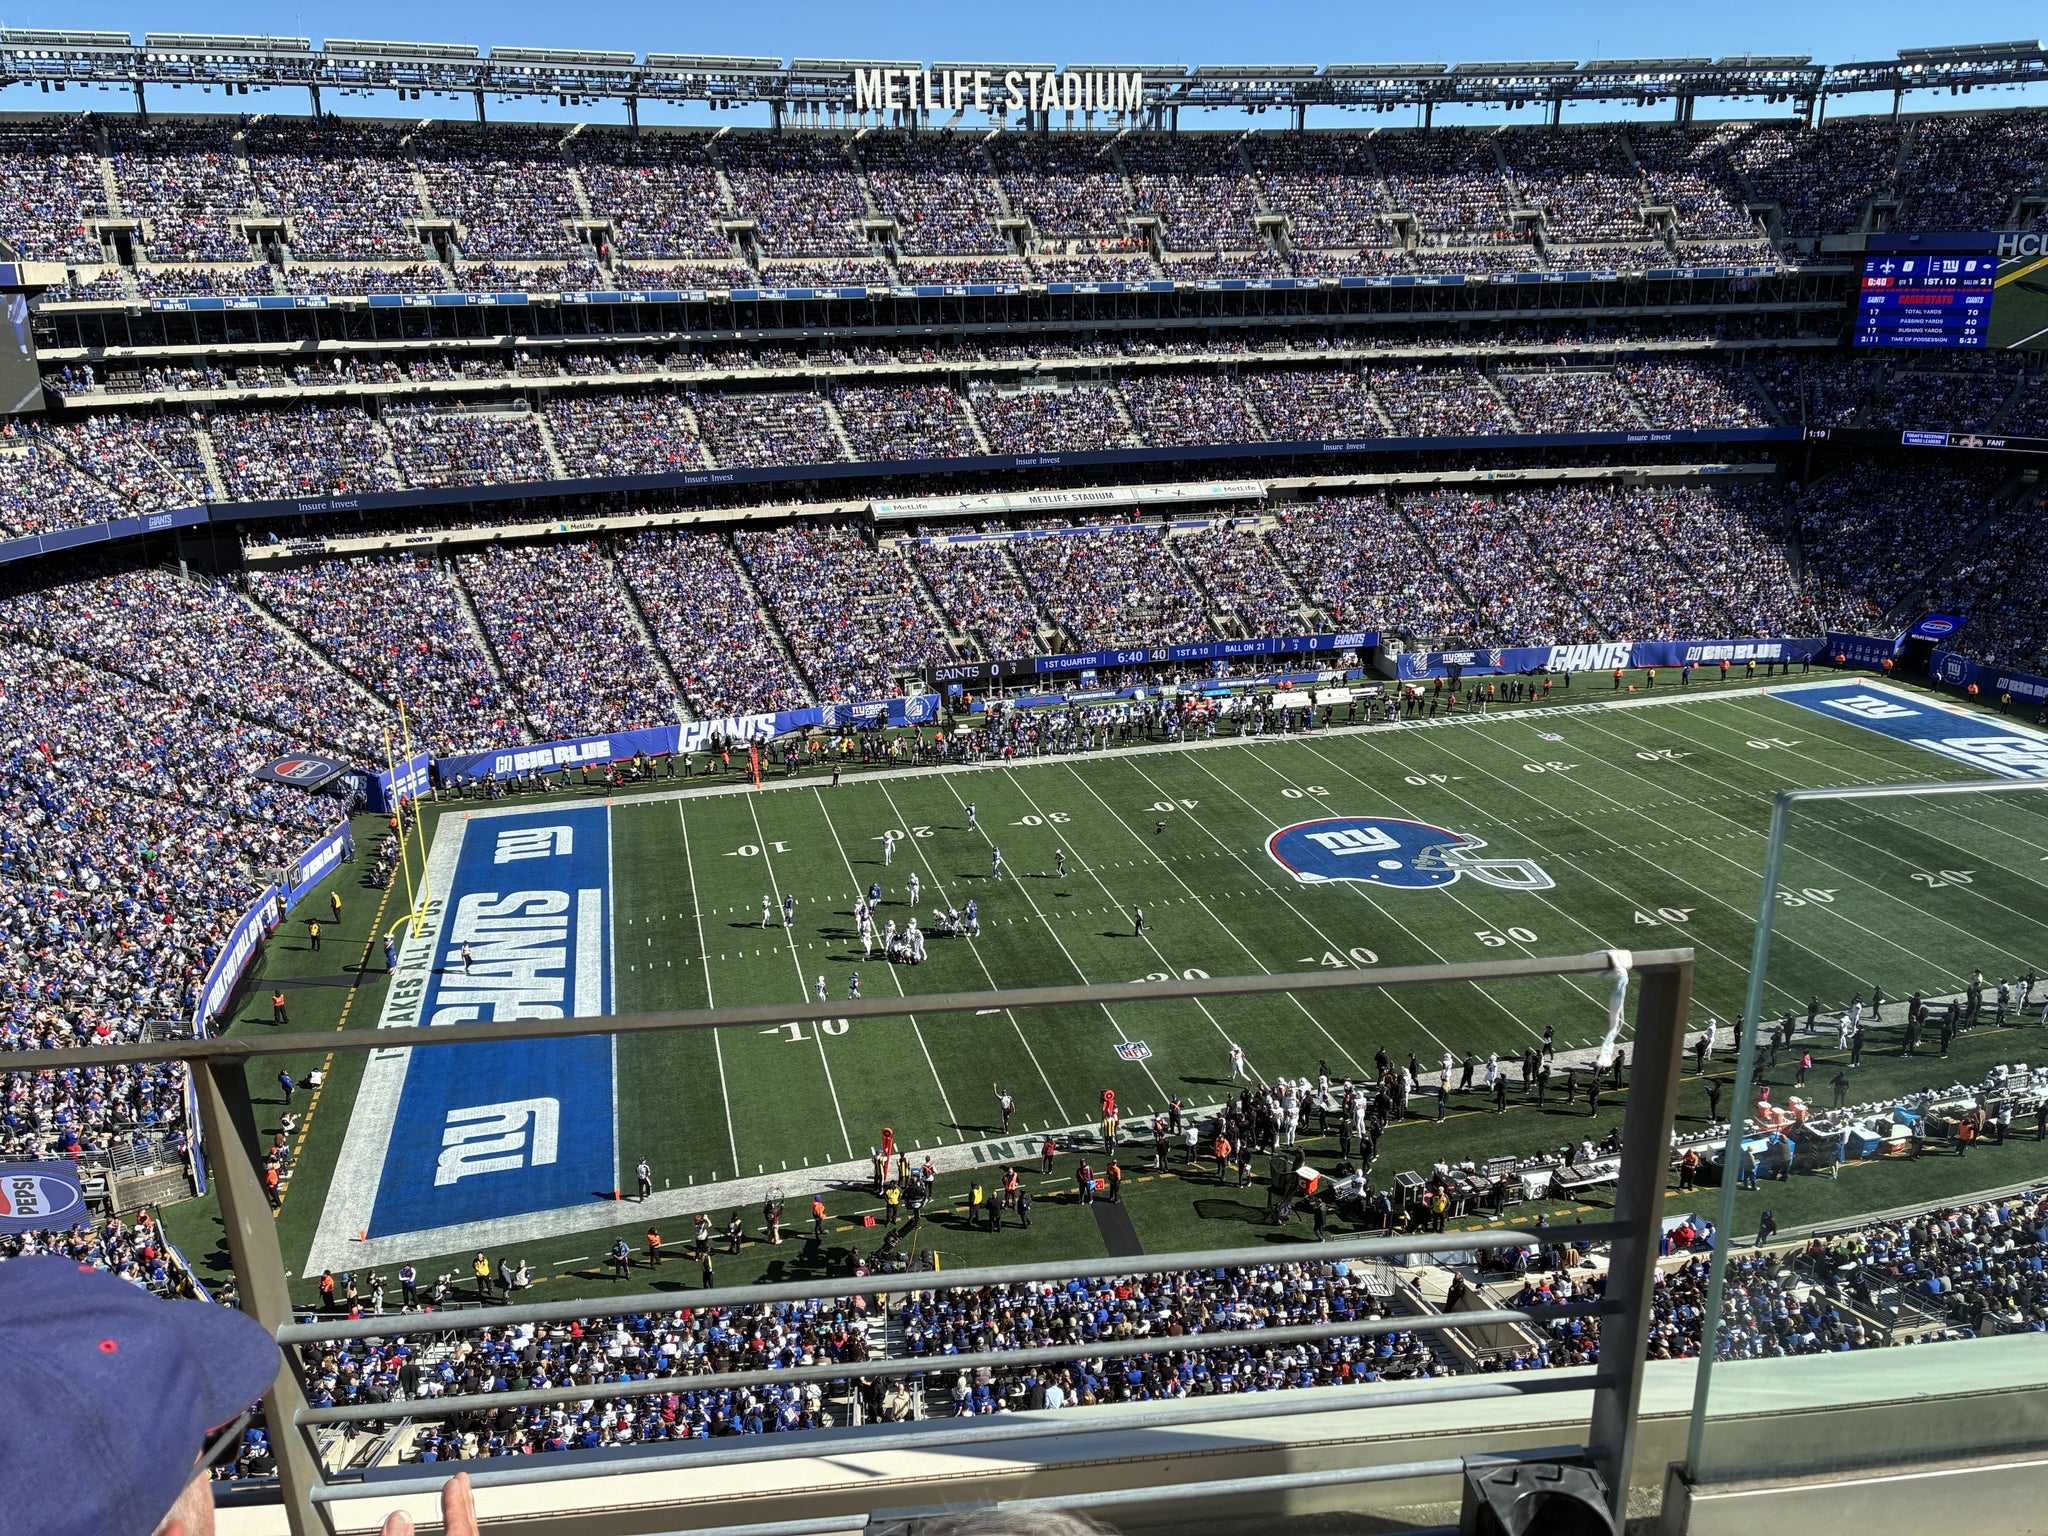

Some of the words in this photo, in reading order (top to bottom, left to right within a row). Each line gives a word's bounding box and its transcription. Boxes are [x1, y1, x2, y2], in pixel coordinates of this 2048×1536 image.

[855, 69, 990, 110] METLIFE
[1004, 71, 1142, 111] STADIUM
[1902, 261, 1914, 272] 0
[1964, 261, 1977, 272] 0
[1868, 278, 1887, 286] 6:40
[1980, 278, 1992, 286] 21
[1966, 296, 1984, 304] GIANTS
[1626, 434, 1648, 442] Insure
[1651, 433, 1672, 441] Invest
[1808, 430, 1826, 438] 1:19
[1987, 439, 2006, 447] FANT
[1015, 457, 1037, 466] Insure
[1039, 456, 1060, 465] Invest
[685, 475, 708, 484] Insure
[711, 474, 734, 482] Invest
[1223, 484, 1256, 494] MetLife
[1029, 494, 1070, 504] METLIFE
[1071, 491, 1114, 502] STADIUM
[298, 502, 327, 511] Insure
[331, 500, 358, 509] Invest
[893, 503, 928, 512] MetLife
[149, 514, 172, 527] GIANTS
[570, 521, 594, 530] MetLife
[405, 536, 433, 544] MOODY'S
[1310, 638, 1317, 649] 0
[1334, 633, 1366, 645] GIANTS
[1176, 648, 1190, 657] 1ST
[1191, 648, 1198, 656] &
[1200, 647, 1209, 655] 10
[1225, 644, 1242, 653] BALL
[1244, 644, 1254, 652] ON
[1257, 642, 1265, 650] 21
[1686, 646, 1702, 661] GO
[1702, 644, 1734, 661] BIG
[1734, 644, 1782, 660] BLUE
[1118, 651, 1144, 663] 6:40
[1152, 649, 1166, 660] 40
[1548, 643, 1633, 671] GIANTS
[1044, 660, 1059, 669] 1ST
[1060, 656, 1097, 667] QUARTER
[1947, 662, 1961, 676] ny
[936, 666, 980, 681] SAINTS
[991, 664, 999, 676] 0
[1011, 666, 1016, 674] 3
[1996, 677, 2008, 689] GO
[2008, 679, 2033, 694] BIG
[852, 706, 864, 717] ny
[1400, 712, 1515, 728] INTERCEPT
[1526, 704, 1609, 716] CANCER
[677, 712, 776, 754] GIANTS
[1746, 737, 1795, 750] 10
[495, 755, 513, 773] GO
[514, 750, 553, 771] BIG
[553, 740, 611, 764] BLUE
[1636, 749, 1684, 762] 20
[1522, 761, 1570, 773] 30
[1404, 773, 1448, 786] 40
[1281, 785, 1330, 798] 50
[1153, 798, 1199, 812] 40
[1021, 812, 1072, 826] 30
[883, 826, 935, 841] 20
[494, 825, 574, 864] ny
[1304, 827, 1401, 856] ny
[738, 841, 792, 857] 10
[1911, 869, 1973, 889] 20
[1775, 887, 1830, 908] 30
[1633, 907, 1689, 928] 40
[1474, 926, 1538, 948] 50
[400, 943, 432, 970] ALL
[1320, 947, 1379, 968] 40
[780, 1019, 850, 1043] 10
[1124, 1048, 1149, 1059] NFL
[434, 1097, 560, 1187] ny
[1095, 1180, 1104, 1189] 20
[12, 1177, 39, 1216] PEPSI
